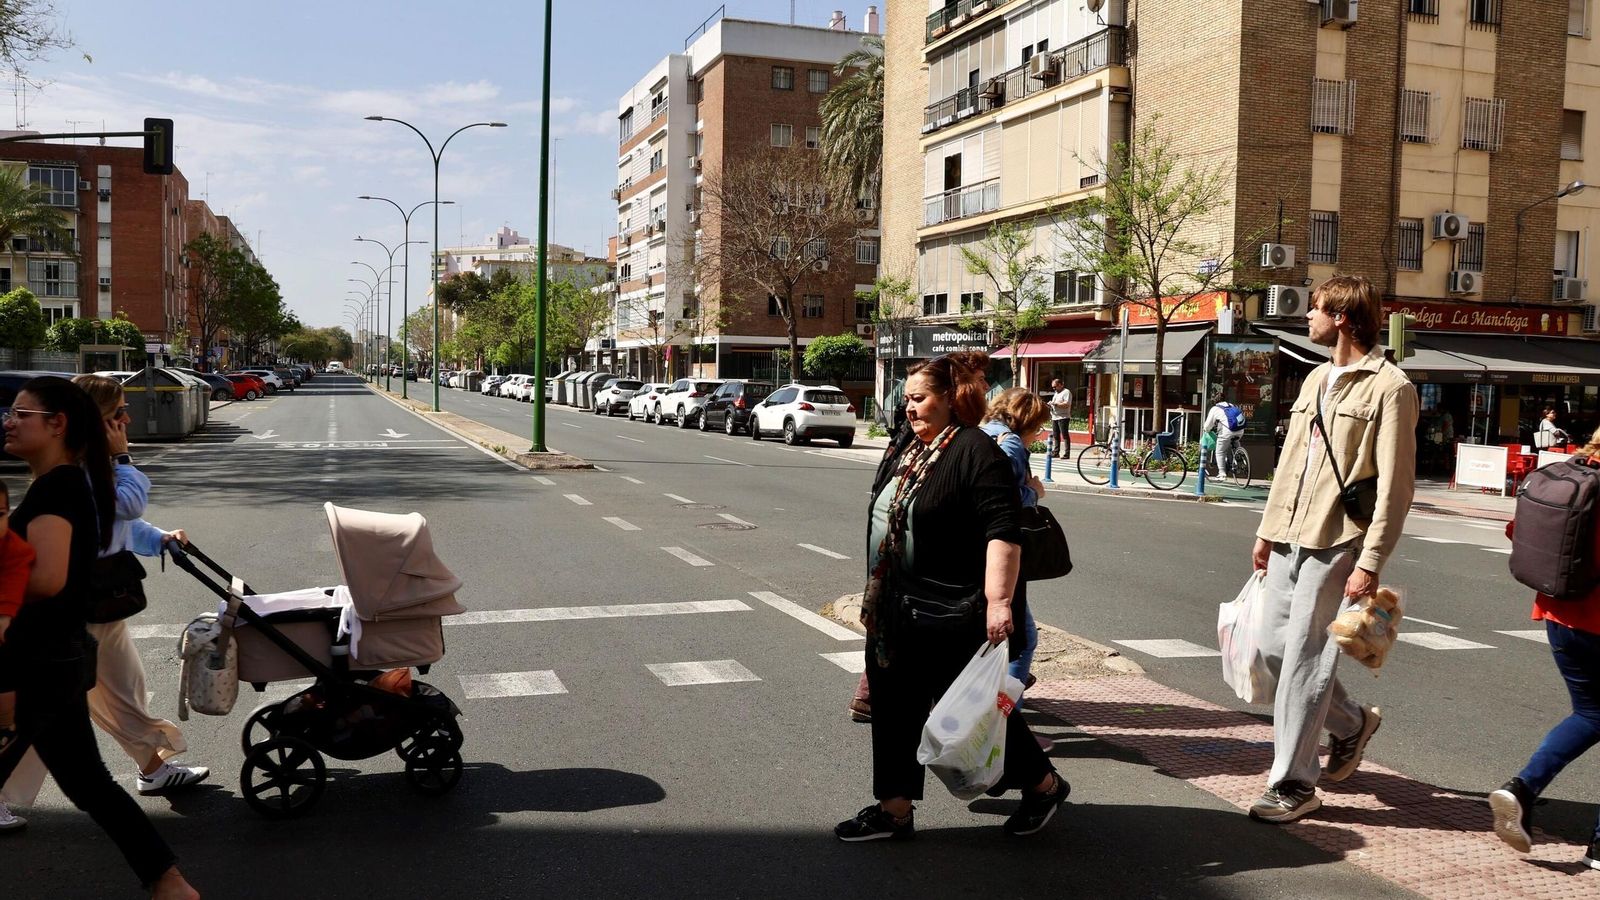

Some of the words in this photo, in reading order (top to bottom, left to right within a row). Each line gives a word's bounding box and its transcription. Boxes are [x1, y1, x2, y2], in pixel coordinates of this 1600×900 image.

[1140, 305, 1151, 316] La
[1451, 310, 1469, 325] La
[1471, 311, 1529, 332] Manchega
[932, 330, 988, 343] metropolitan
[932, 344, 945, 352] café
